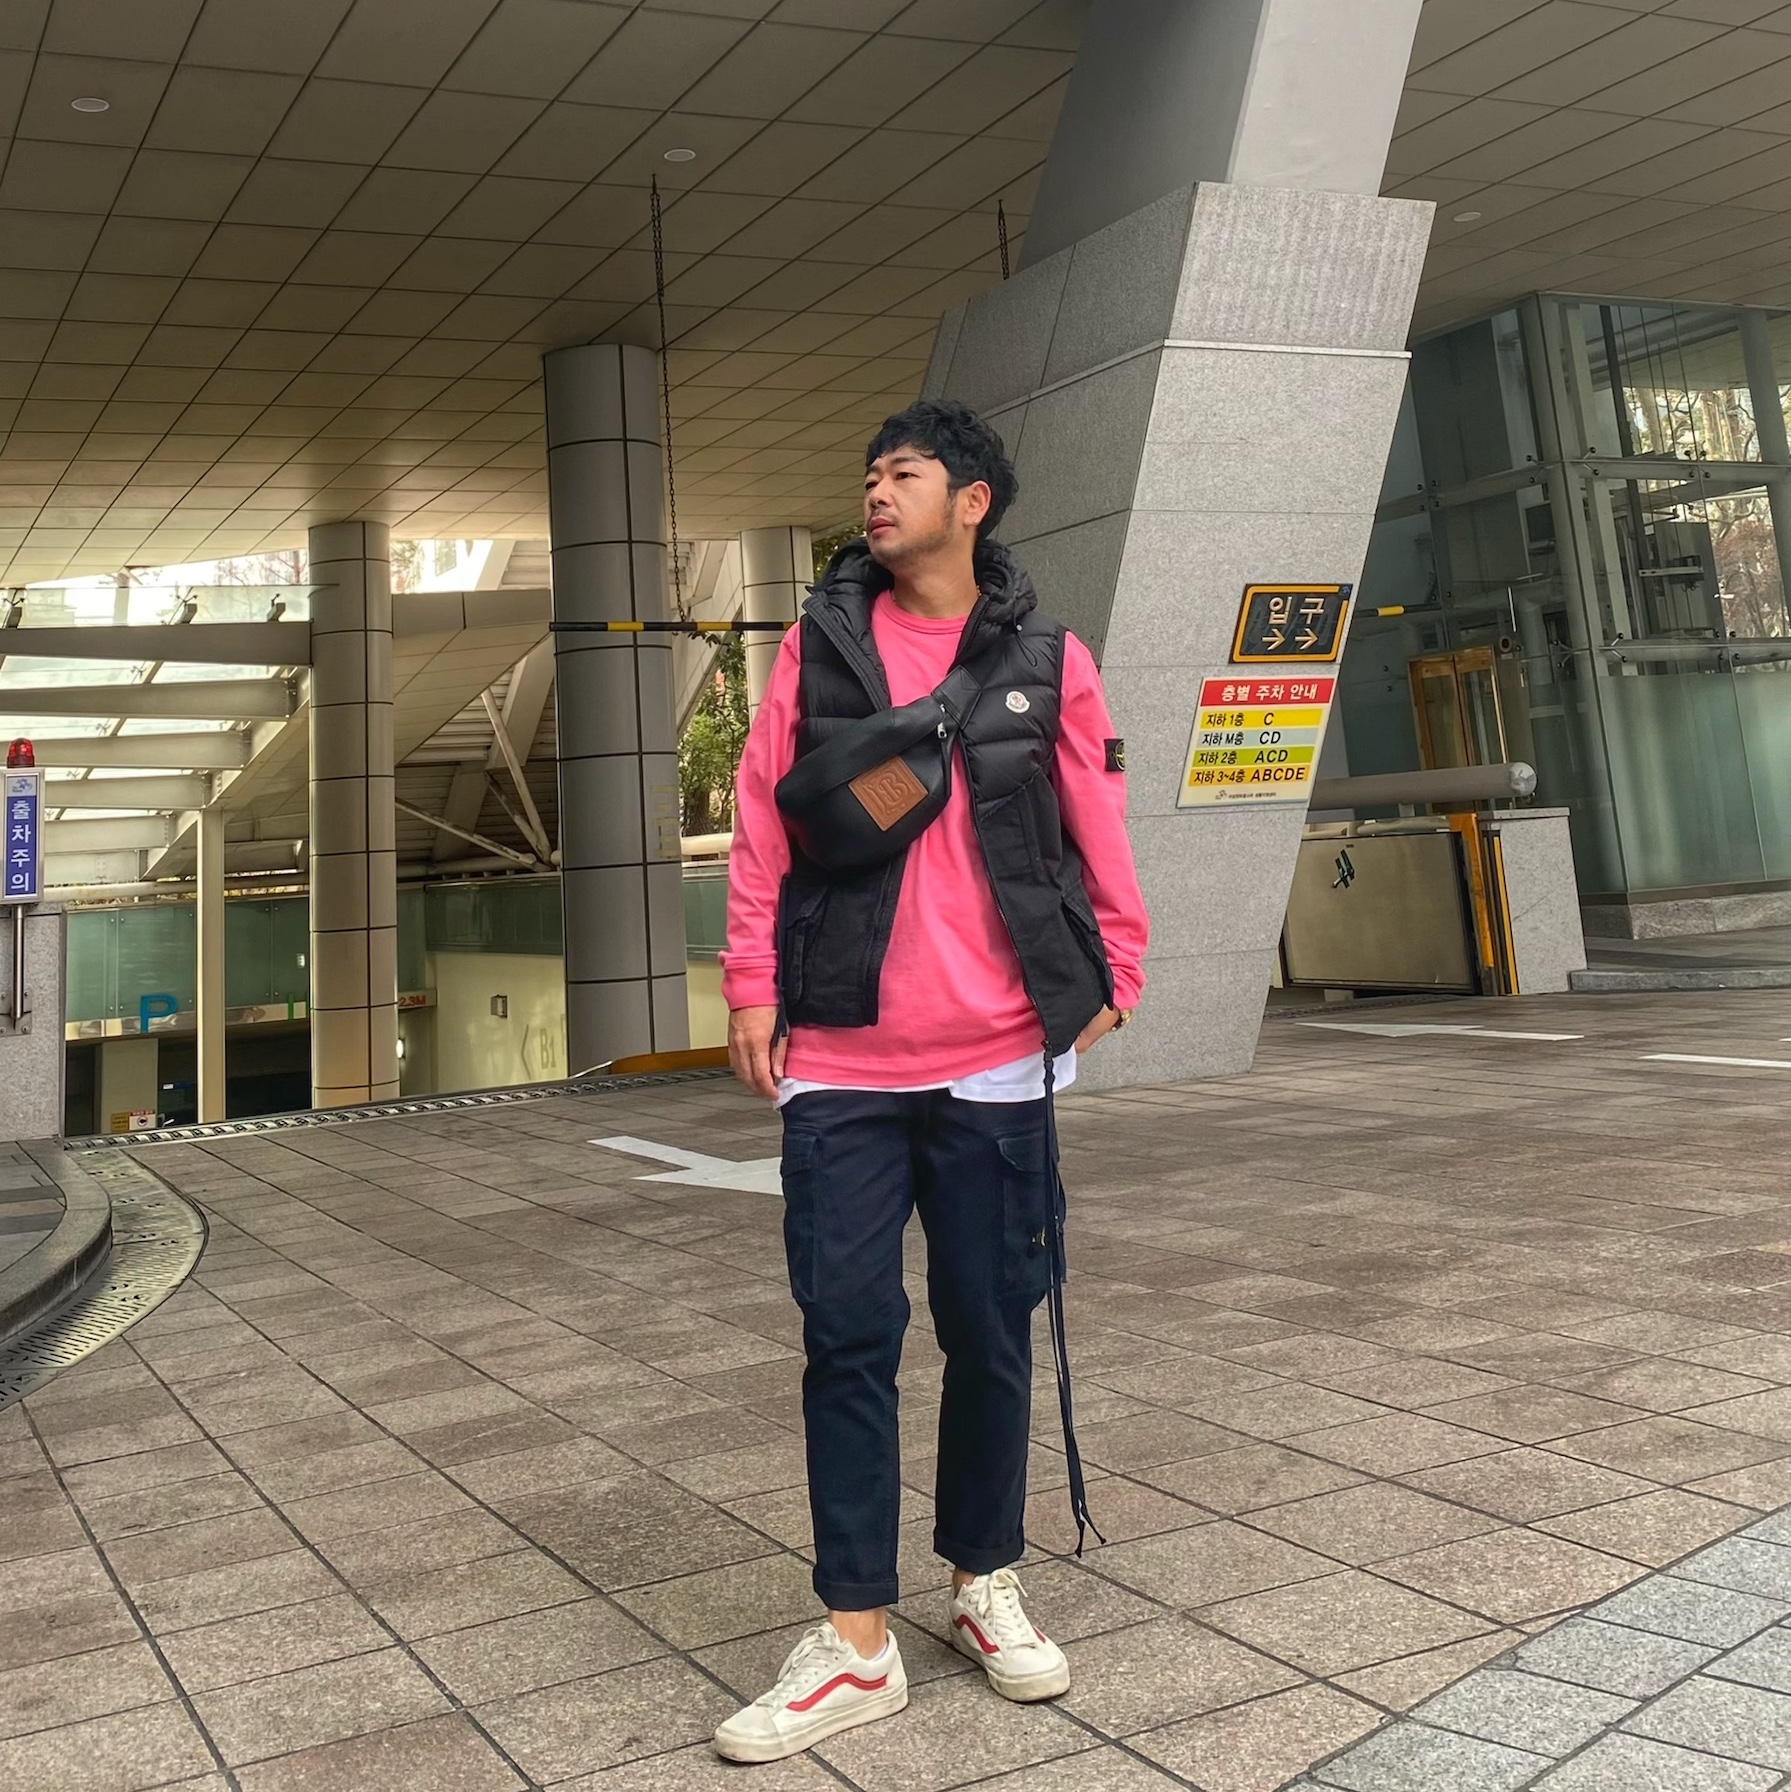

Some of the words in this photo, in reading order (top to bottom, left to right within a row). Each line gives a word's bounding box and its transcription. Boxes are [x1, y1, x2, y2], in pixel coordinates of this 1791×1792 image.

[1268, 596, 1325, 625] 입구
[1221, 685, 1251, 702] 층별
[1255, 684, 1285, 701] 주차
[1289, 683, 1318, 700] 안내
[1206, 713, 1227, 727] 지하
[1229, 712, 1245, 727] 1층
[1263, 712, 1275, 726] C
[1202, 732, 1223, 746] 지하
[1224, 731, 1245, 746] M층
[1259, 731, 1281, 745] CD
[1198, 751, 1219, 765] 지하
[1220, 750, 1238, 765] 2층
[1254, 749, 1289, 764] ACD
[1194, 771, 1215, 784] 지하
[1216, 769, 1246, 783] 3~4층
[1250, 767, 1306, 783] ABCDE
[140, 993, 179, 1034] P
